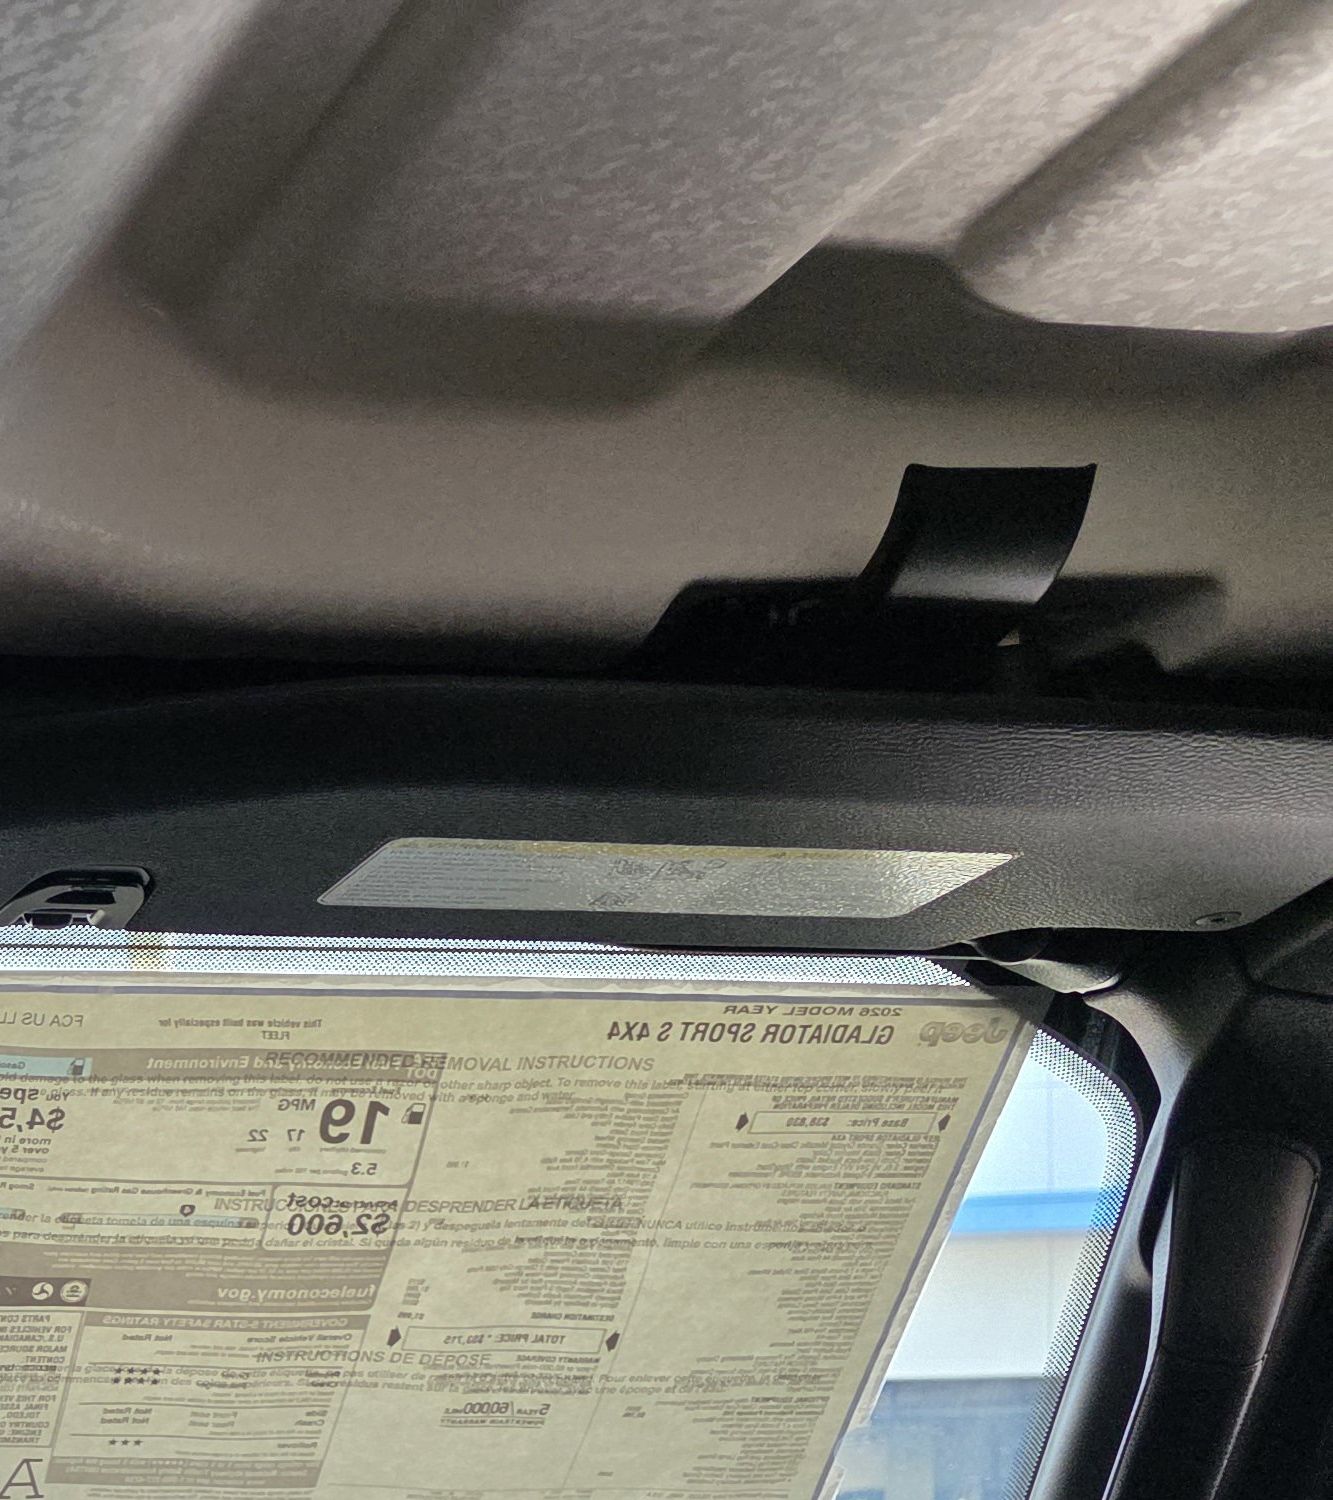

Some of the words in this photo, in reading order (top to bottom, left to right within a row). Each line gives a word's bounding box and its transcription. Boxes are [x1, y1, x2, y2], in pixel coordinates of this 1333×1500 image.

[420, 1053, 512, 1071] REMOVAL
[516, 1055, 655, 1072] INSTRUCTIONS
[403, 1199, 516, 1214] DESPRENDER
[388, 1352, 415, 1365] DE
